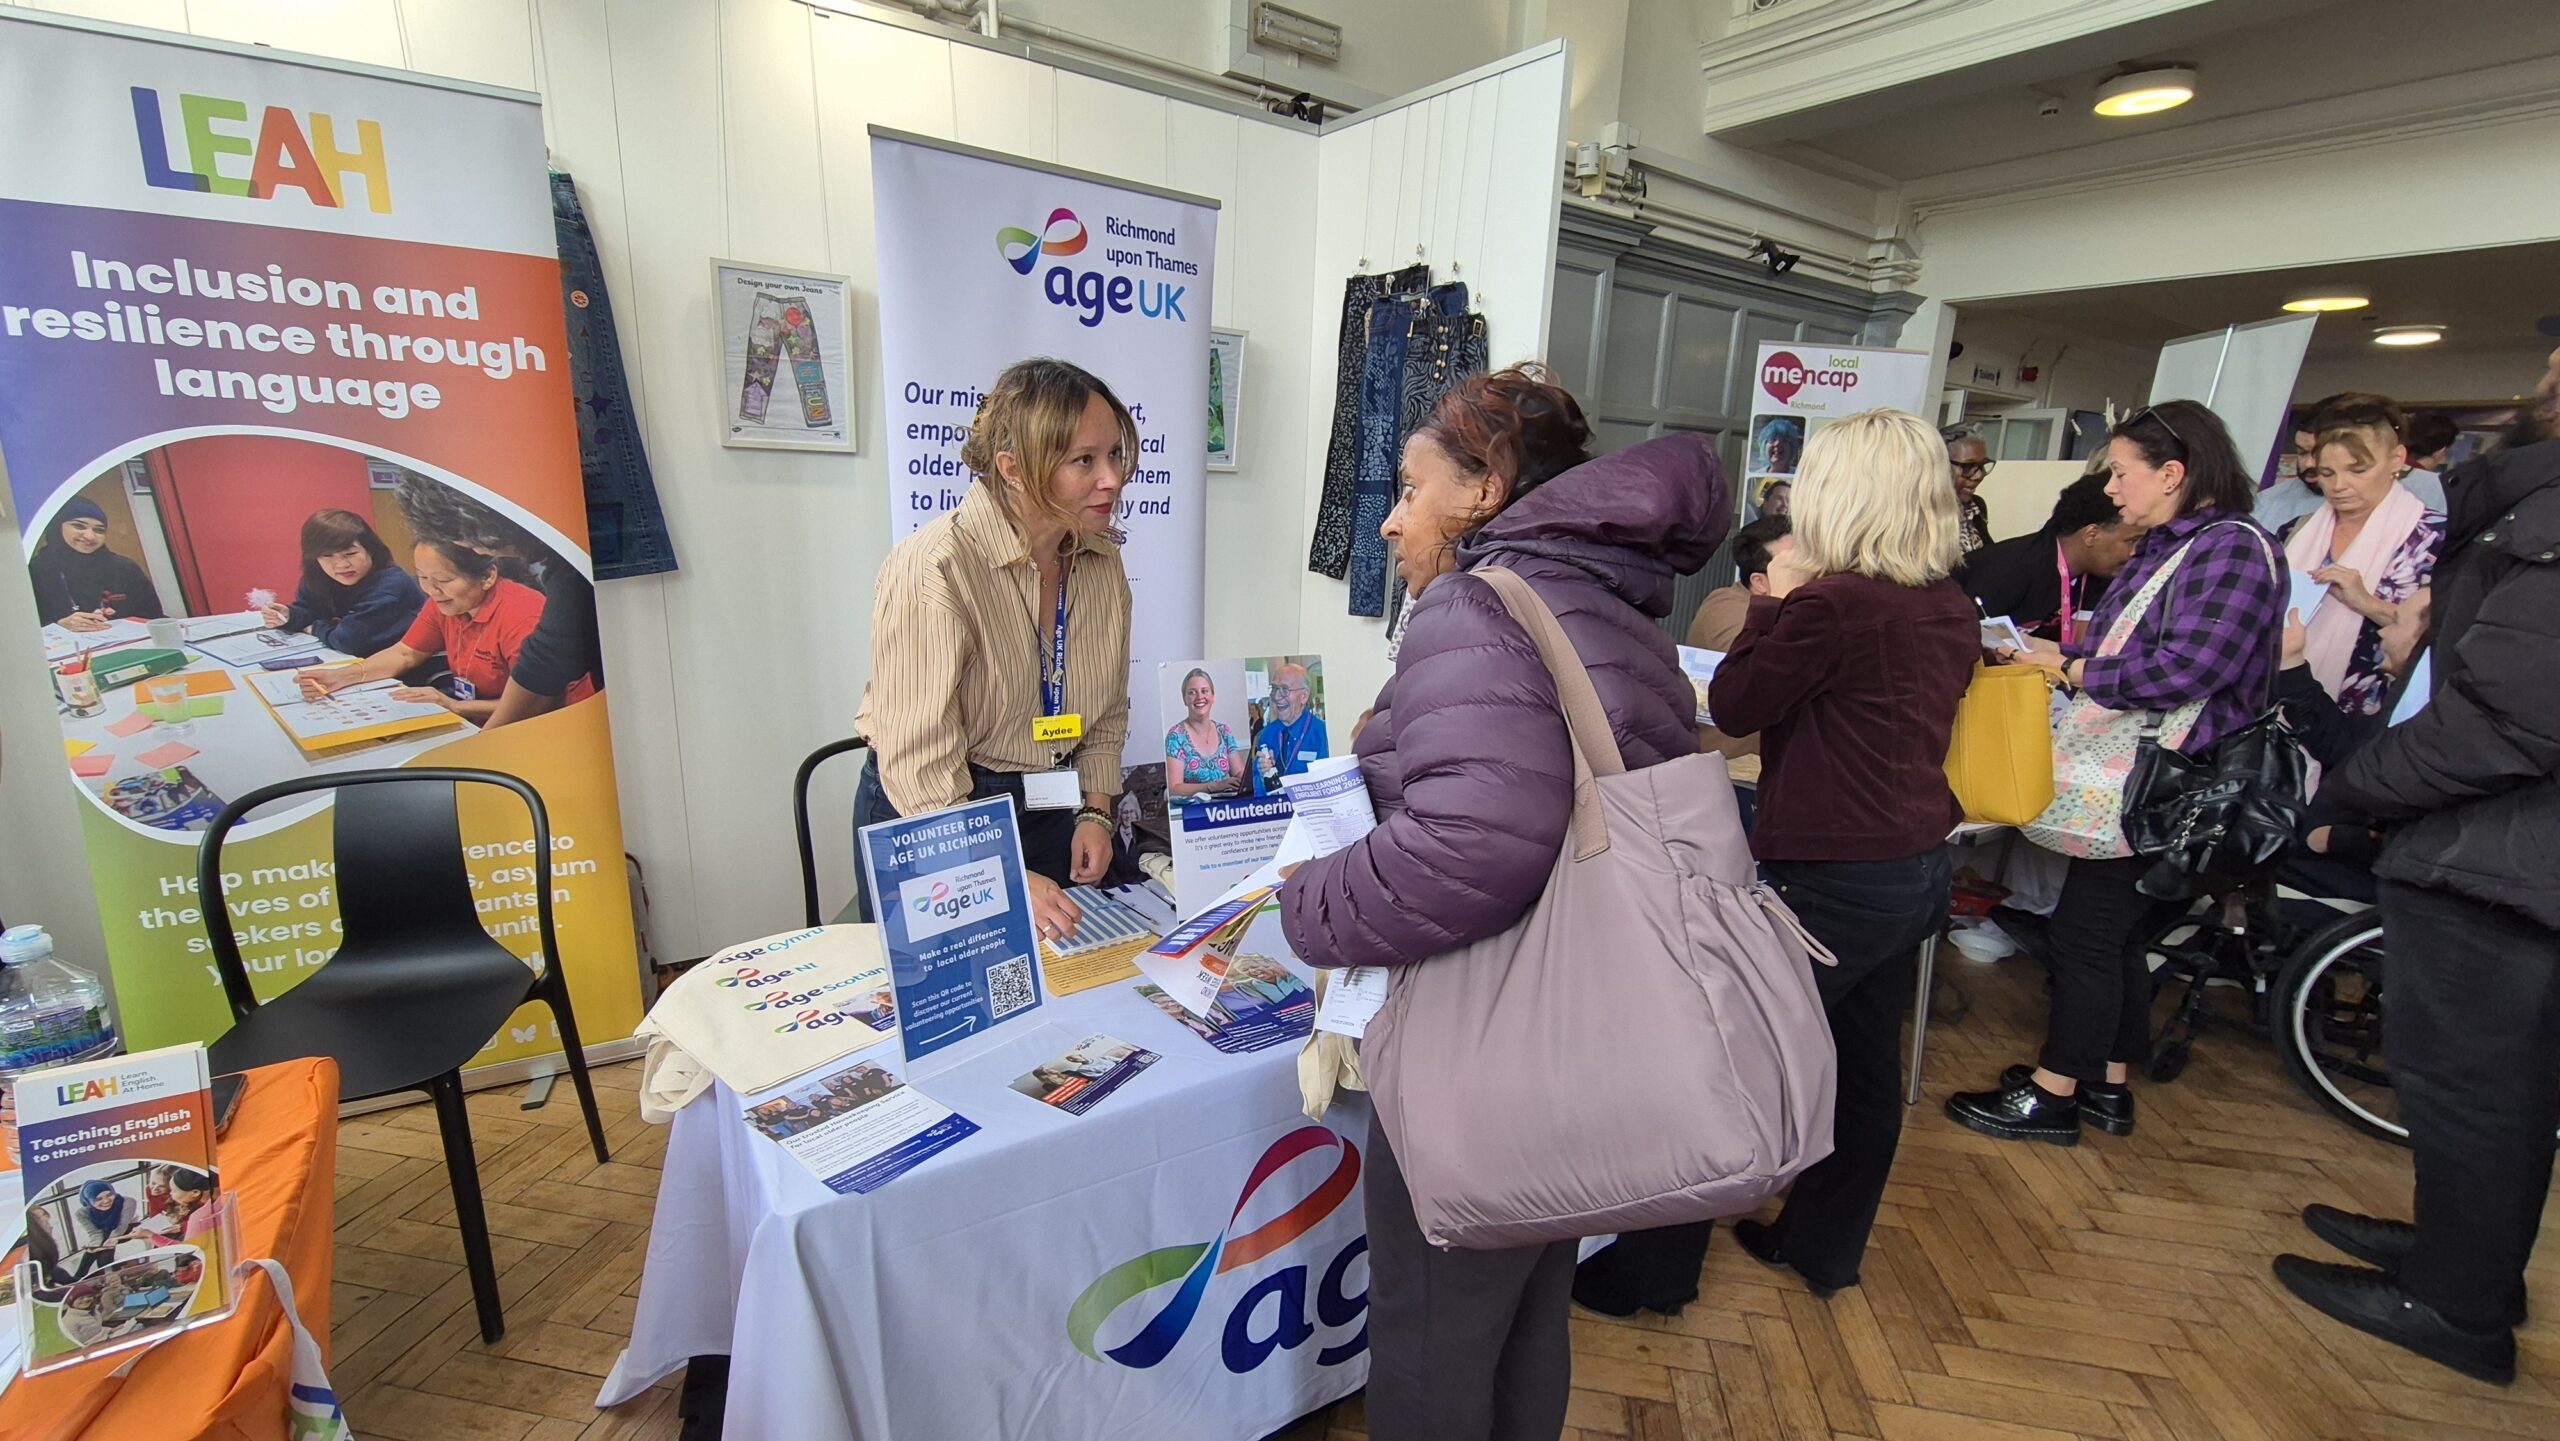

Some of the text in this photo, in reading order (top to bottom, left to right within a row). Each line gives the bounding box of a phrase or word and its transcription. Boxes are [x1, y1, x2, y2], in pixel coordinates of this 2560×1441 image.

[130, 86, 392, 214] LEAH
[1106, 216, 1176, 246] Richmond
[1106, 248, 1198, 276] upon Thames
[71, 250, 479, 321] Inclusion and
[737, 278, 763, 288] Design
[765, 282, 782, 290] your
[802, 285, 823, 294] Jeans
[1044, 266, 1187, 327] age UK
[2, 301, 546, 379] resilience through
[1829, 355, 1859, 369] local
[155, 359, 441, 419] language
[1764, 366, 1858, 392] mencap
[904, 382, 944, 405] Our
[1790, 401, 1826, 411] Richmond
[908, 453, 964, 477] older
[1130, 464, 1171, 484] hem
[911, 489, 964, 511] to liv
[1139, 496, 1171, 515] and
[1056, 639, 1064, 651] UK
[1041, 727, 1073, 738] Aydee
[1322, 785, 1342, 796] FORM
[1205, 798, 1294, 822] Volunteerin
[892, 815, 991, 848] VOLUNTEER FOR
[1208, 832, 1238, 841] volunteering
[1240, 828, 1271, 837] opportunities
[889, 828, 1003, 867] AGE UK RICHMOND
[1221, 847, 1248, 855] confidence
[159, 871, 243, 896] Hep
[252, 859, 336, 886] mak
[955, 869, 985, 883] Richmond
[957, 876, 996, 893] upon Thames
[138, 907, 200, 929] the
[298, 886, 330, 909] of
[491, 859, 597, 886] asyum
[934, 887, 994, 919] age UK
[186, 920, 322, 953] sekers
[718, 927, 825, 964] age Cymru
[919, 949, 941, 961] Make
[950, 939, 966, 951] real
[968, 927, 1006, 945] difference
[206, 952, 287, 987] yur
[923, 938, 1006, 973] to local older people
[745, 962, 819, 988] age NI
[774, 988, 824, 1009] age
[822, 966, 886, 992] Scotlan
[912, 998, 927, 1008] Scan
[928, 993, 940, 1002] this
[940, 988, 950, 997] QR
[950, 984, 964, 993] code
[914, 1004, 939, 1018] discover
[952, 990, 973, 1003] current
[905, 1012, 944, 1032] volunteering
[944, 996, 984, 1016] opportunities
[121, 1071, 148, 1080] Learn
[121, 1076, 156, 1087] English
[137, 1081, 165, 1092] Home
[57, 1076, 119, 1106] LEAH
[29, 1109, 191, 1150] Teaching English
[32, 1122, 192, 1163] to those most in need
[1221, 1234, 1369, 1374] ag
